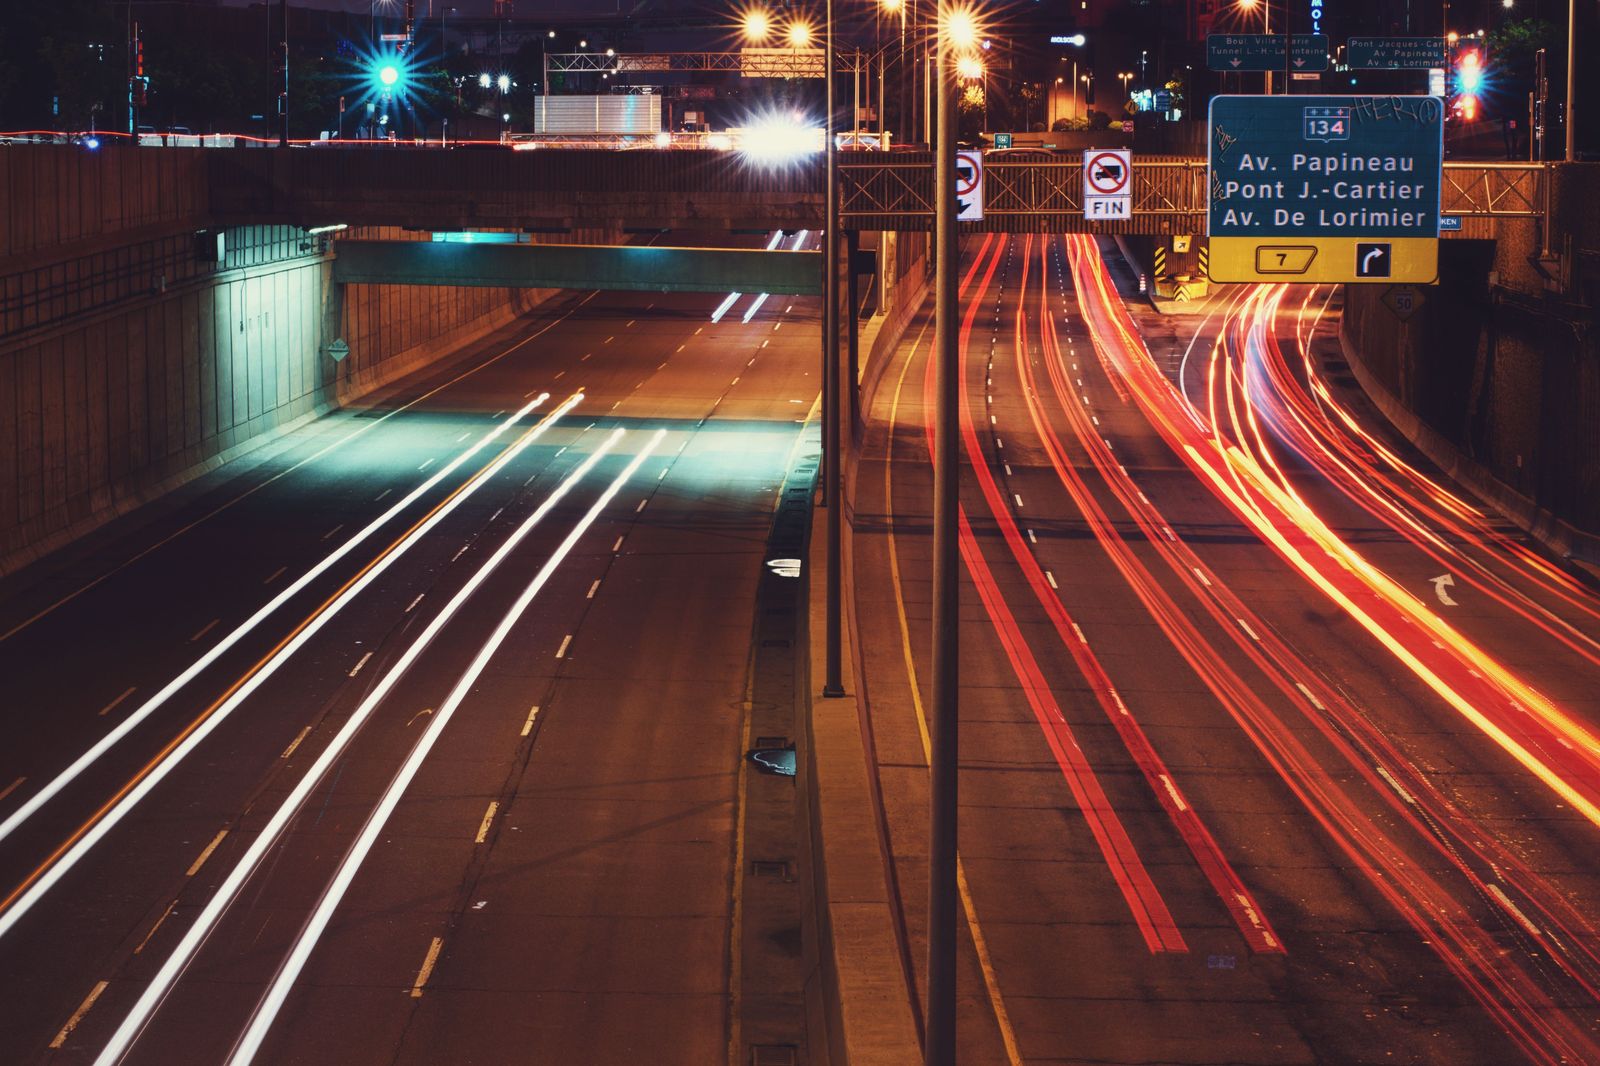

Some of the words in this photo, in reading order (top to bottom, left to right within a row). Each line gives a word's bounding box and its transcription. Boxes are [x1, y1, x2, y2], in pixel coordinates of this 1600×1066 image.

[1311, 0, 1322, 35] MOL
[1211, 46, 1242, 55] Tunnel
[1351, 40, 1373, 48] Pont
[1378, 40, 1460, 48] Jacques-Carer
[1394, 49, 1439, 58] Papineau
[1403, 58, 1445, 66] Lorimier
[1309, 120, 1345, 135] 134
[1239, 153, 1278, 171] Av.
[1293, 153, 1414, 176] Papineau
[1226, 180, 1284, 199] Pont
[1299, 180, 1424, 199] J.-Cartier
[1093, 201, 1124, 215] FIN
[1223, 209, 1260, 227] Av.
[1274, 209, 1305, 227] De
[1319, 209, 1426, 227] Lorimier
[1276, 253, 1287, 266] 7
[1397, 297, 1412, 310] 50
